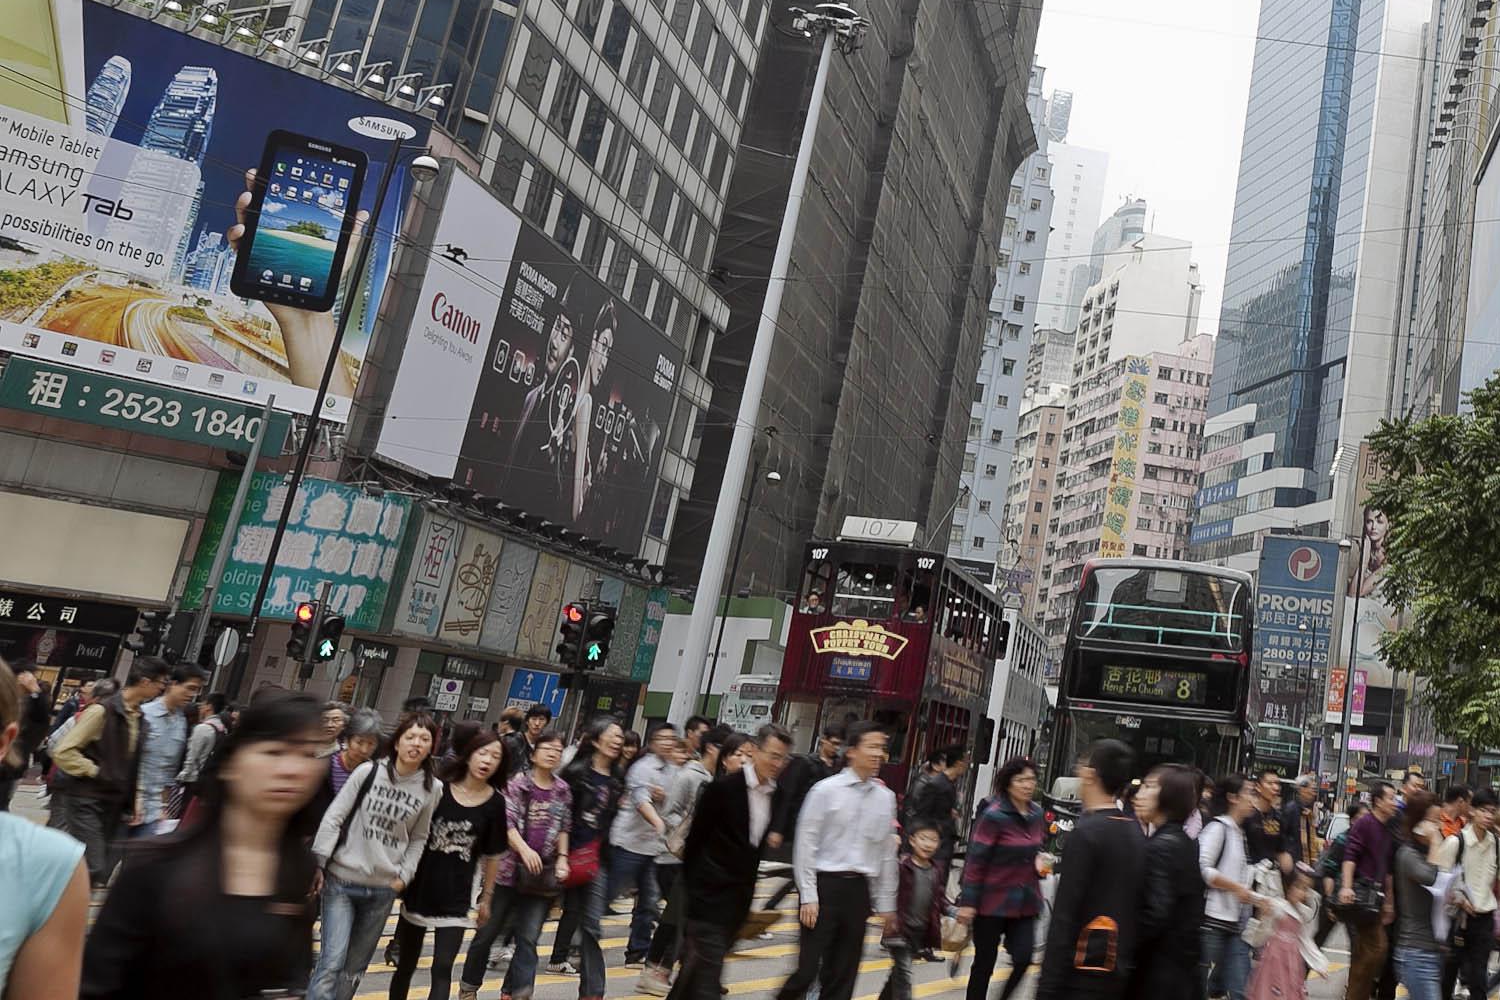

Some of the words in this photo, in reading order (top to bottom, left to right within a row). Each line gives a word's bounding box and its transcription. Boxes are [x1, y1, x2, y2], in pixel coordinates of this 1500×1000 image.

[358, 117, 407, 140] SAMSUNG
[9, 120, 55, 147] Mobile
[60, 135, 101, 160] Tablet
[0, 145, 84, 188] amsung
[0, 169, 76, 207] LAXY
[80, 193, 134, 221] Tab
[1, 213, 93, 248] possibilities
[95, 238, 114, 254] on
[119, 241, 143, 261] the
[144, 251, 165, 268] go.
[430, 292, 481, 345] Canon
[100, 388, 183, 427] 2523
[191, 407, 263, 443] 1840
[859, 519, 902, 538] 107
[811, 548, 828, 560] 107
[917, 558, 936, 570] 107
[1258, 593, 1333, 615] PROMIS
[829, 629, 888, 644] CHRISTMAS
[863, 640, 890, 654] TOWN
[1263, 648, 1294, 660] 2808
[1298, 651, 1327, 663] 0733
[1103, 680, 1124, 694] Heng
[1125, 682, 1137, 693] Fa
[1177, 679, 1191, 699] 8
[1264, 702, 1288, 720] 周生生
